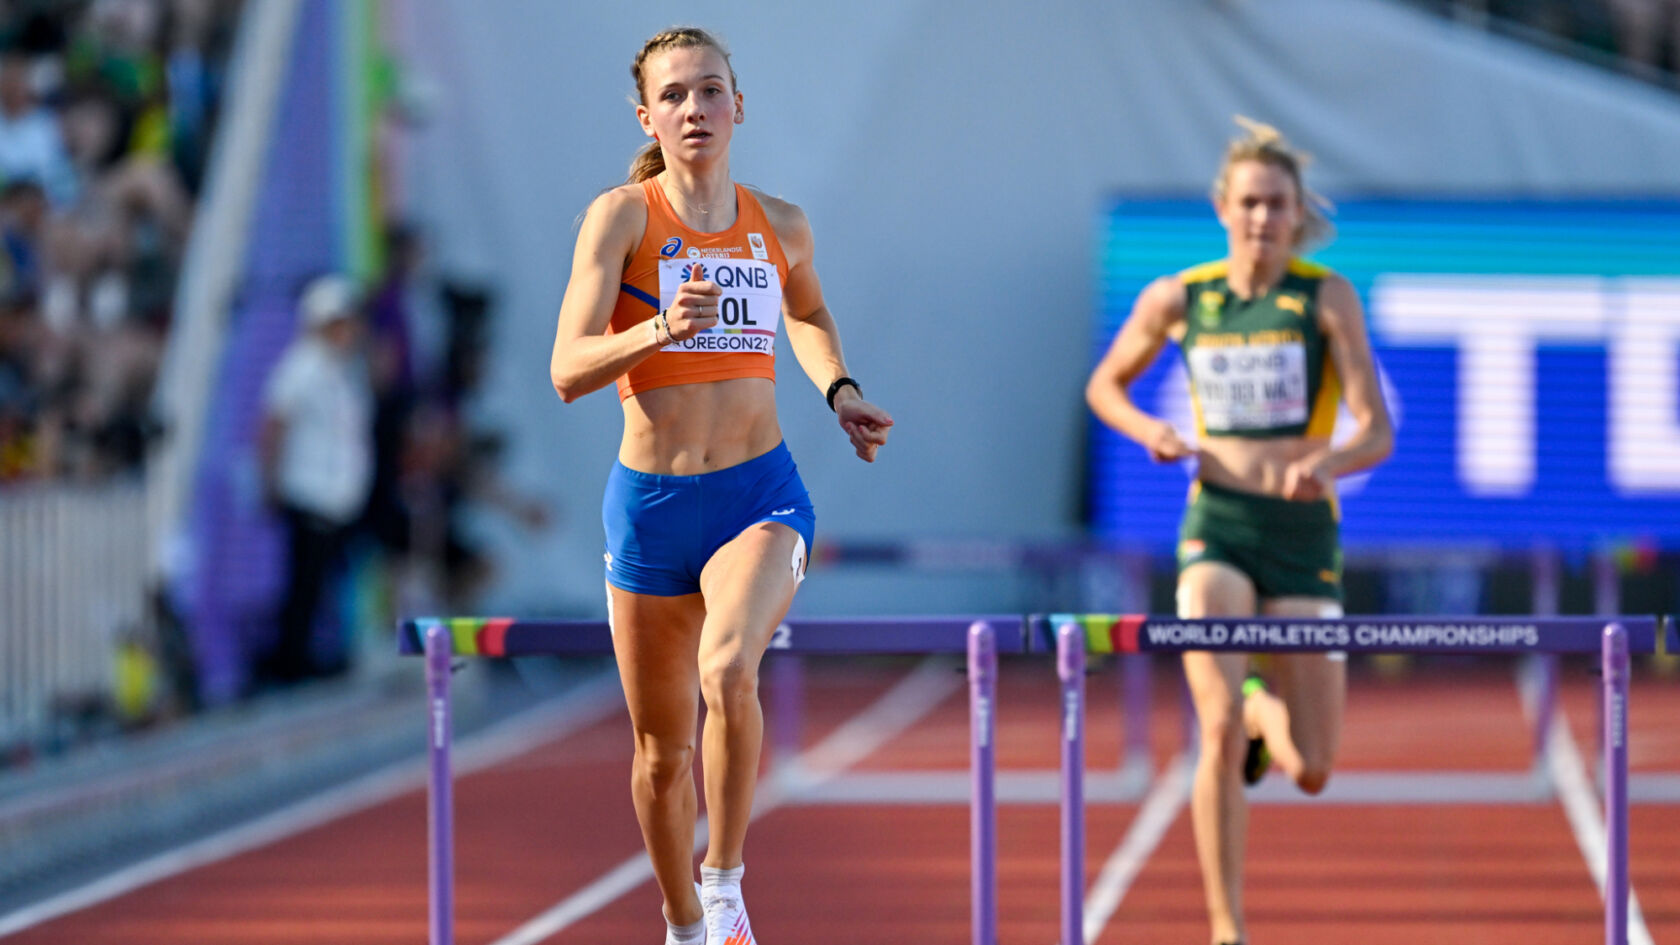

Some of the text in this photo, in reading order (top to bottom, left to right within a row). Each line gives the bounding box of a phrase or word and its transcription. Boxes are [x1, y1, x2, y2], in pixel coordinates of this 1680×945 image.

[715, 265, 768, 289] QNB
[716, 297, 757, 326] OL
[683, 336, 769, 352] OREGON22
[1147, 624, 1539, 646] WORLD ATHLETICS CHAMPIONSHIPS
